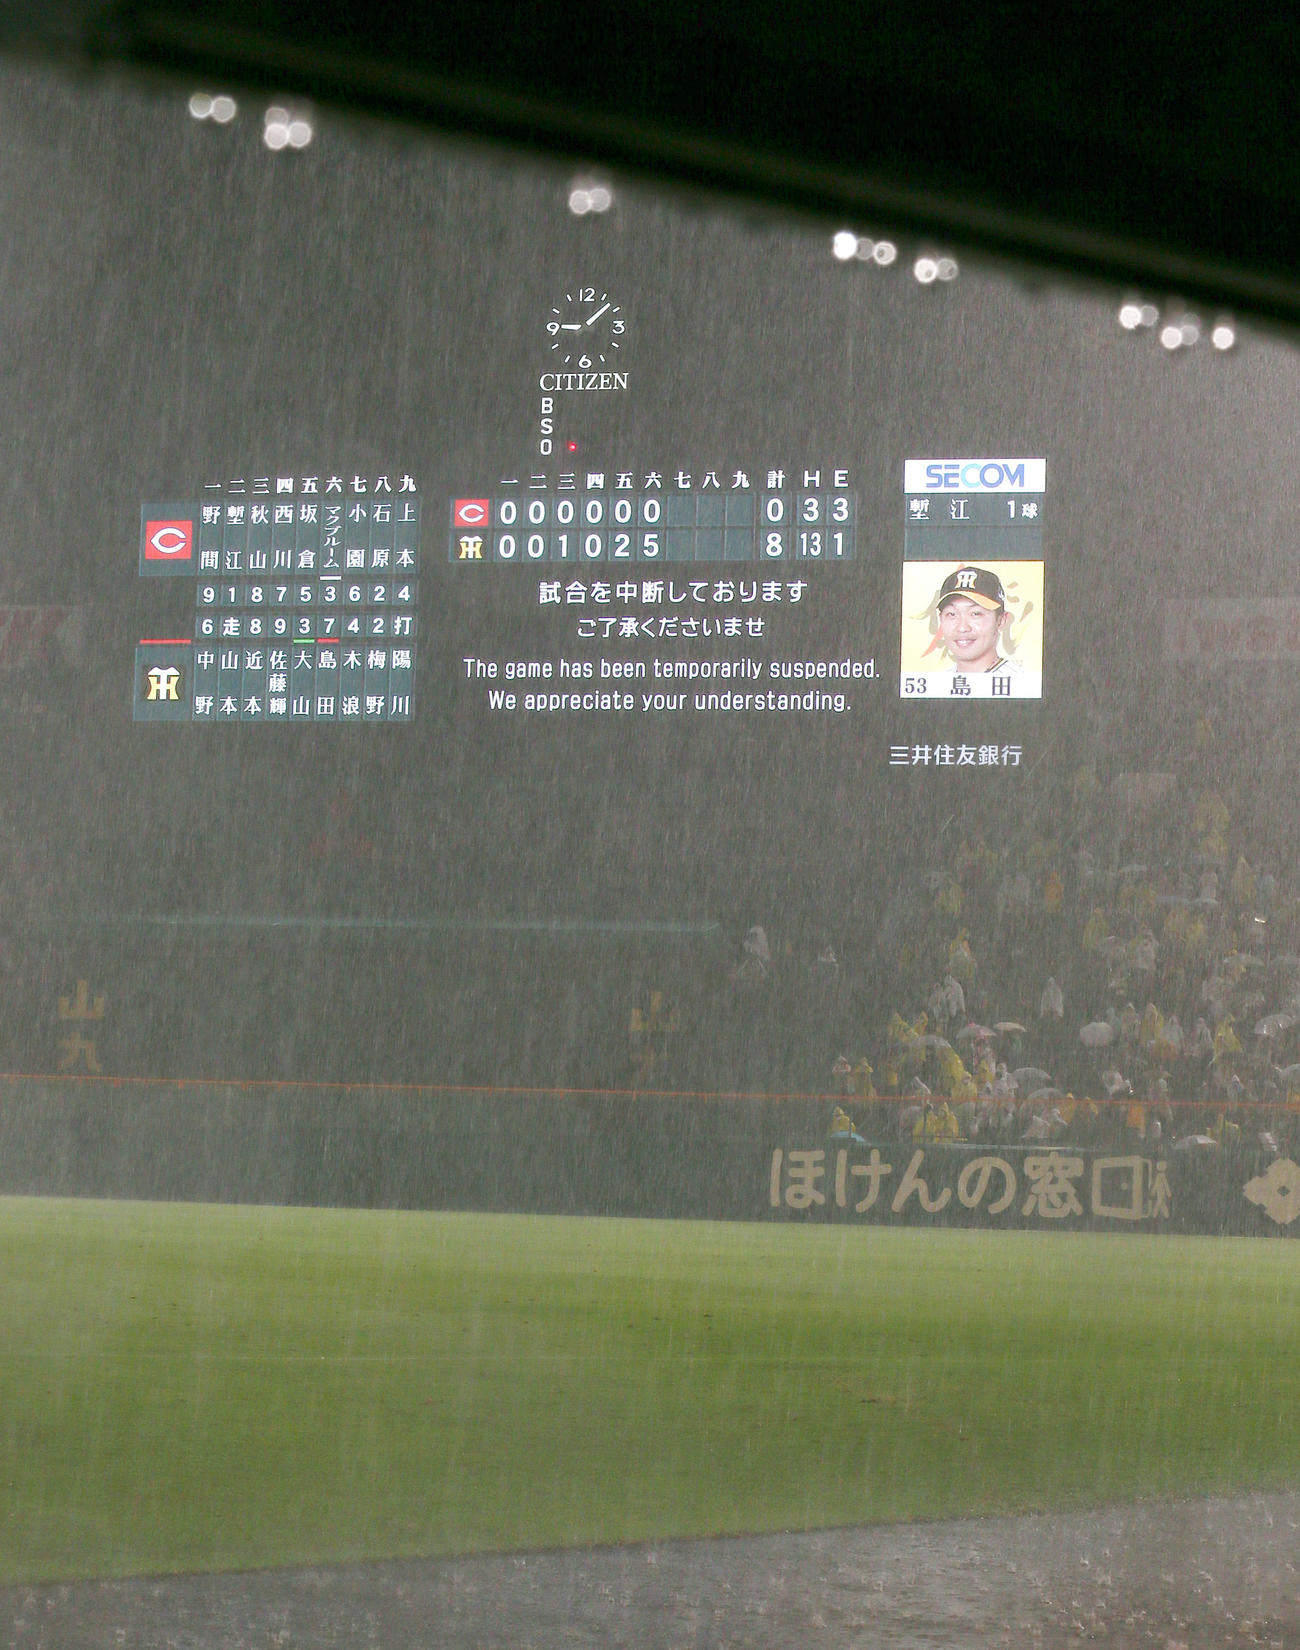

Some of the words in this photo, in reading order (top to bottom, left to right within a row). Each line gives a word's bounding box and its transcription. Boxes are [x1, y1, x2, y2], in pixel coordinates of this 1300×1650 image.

[579, 287, 596, 302] 12
[546, 321, 560, 336] 9
[612, 320, 625, 334] 3
[578, 354, 592, 369] 6
[539, 372, 629, 391] CITIZEN
[541, 397, 554, 414] B
[540, 417, 554, 435] S
[228, 479, 246, 493] 二
[252, 477, 270, 494] 三
[276, 477, 294, 494] 四
[300, 476, 319, 494] 五
[325, 476, 343, 494] 六
[349, 475, 367, 493] 七
[374, 475, 392, 493] 八
[398, 474, 417, 493] 九
[529, 474, 548, 489] 二
[557, 472, 576, 490] 三
[586, 472, 605, 490] 四
[614, 471, 634, 489] 五
[644, 471, 663, 489] 六
[673, 471, 692, 489] 七
[701, 471, 721, 489] 八
[731, 470, 750, 489] 九
[767, 469, 786, 489] 計
[803, 470, 820, 488] H
[834, 469, 849, 488] E
[926, 463, 1025, 488] SECOM
[499, 500, 517, 525] 0
[528, 500, 546, 525] 0
[557, 500, 574, 524] 0
[585, 499, 603, 524] 0
[614, 499, 632, 524] 0
[643, 499, 661, 523] 0
[766, 497, 784, 522] 0
[802, 497, 820, 522] 3
[832, 497, 849, 522] 3
[1007, 499, 1039, 519] 1球
[200, 505, 221, 570] 野間
[224, 505, 245, 570] 塹江
[249, 504, 269, 570] 秋山
[273, 504, 294, 569] 西川
[297, 504, 318, 569] 坂倉
[323, 505, 342, 568] マクブルーム
[346, 503, 367, 569] 小園
[371, 503, 392, 568] 石原
[395, 502, 416, 568] 上本
[498, 534, 516, 559] 0
[527, 534, 545, 558] 0
[558, 534, 568, 558] 1
[584, 533, 602, 558] 0
[614, 533, 630, 557] 2
[643, 533, 659, 558] 5
[765, 532, 783, 557] 8
[800, 532, 822, 556] 13
[833, 532, 843, 556] 1
[203, 586, 215, 603] 9
[228, 586, 236, 603] 1
[250, 586, 263, 603] 8
[276, 586, 287, 602] 7
[300, 586, 312, 602] 5
[324, 585, 336, 602] 3
[348, 585, 361, 602] 6
[373, 585, 386, 602] 2
[397, 585, 411, 601] 4
[539, 579, 808, 605] 試合を中断しております
[201, 618, 214, 635] 6
[222, 616, 241, 637] 走
[249, 618, 262, 635] 8
[274, 618, 286, 635] 9
[298, 617, 311, 634] 3
[323, 617, 335, 634] 7
[347, 617, 360, 634] 4
[372, 617, 385, 634] 2
[393, 615, 413, 635] 打
[577, 616, 766, 638] ご了承くださいませ
[195, 650, 215, 715] 中野
[219, 650, 239, 715] 山本
[243, 650, 264, 715] 近本
[268, 650, 288, 715] 佐藤輝
[292, 650, 313, 715] 大山
[317, 649, 337, 715] 島田
[341, 649, 362, 716] 木浪
[365, 649, 387, 715] 梅野
[390, 649, 411, 716] 陽川
[463, 658, 498, 678] The
[505, 662, 553, 680] game
[559, 658, 593, 678] has
[600, 658, 646, 678] been
[653, 658, 763, 680] temporarily
[769, 658, 880, 680] suspended.
[905, 677, 927, 694] 53
[950, 674, 1011, 697] 島田
[488, 690, 517, 710] We
[524, 690, 634, 712] appreciate
[641, 694, 688, 712] your
[695, 690, 851, 712] understanding.
[888, 743, 1023, 766] 三井住友銀行
[769, 1148, 1144, 1220] ほけんの窓口
